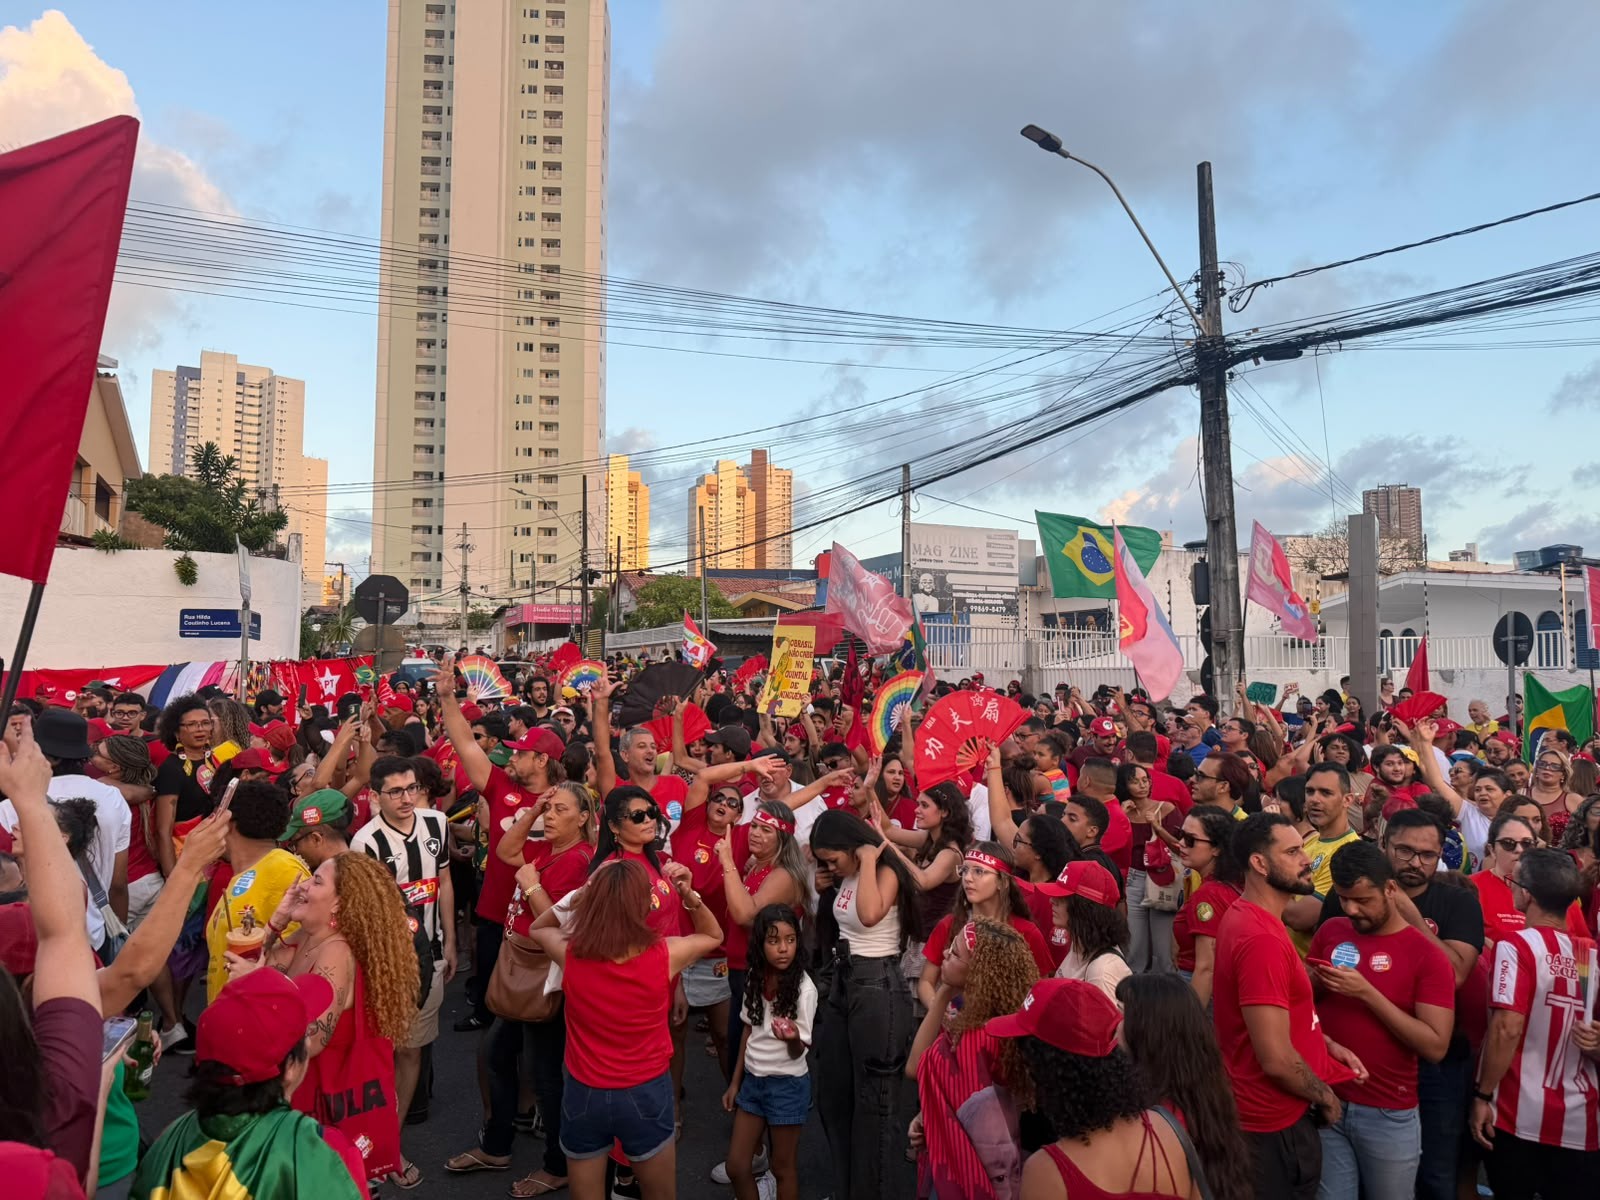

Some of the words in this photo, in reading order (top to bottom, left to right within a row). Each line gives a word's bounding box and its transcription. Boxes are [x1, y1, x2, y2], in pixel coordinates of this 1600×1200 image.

[788, 648, 800, 657] NÃO
[800, 650, 814, 659] CABE
[794, 660, 804, 669] NO
[784, 671, 808, 680] QUINTAL
[324, 680, 335, 689] PT
[789, 681, 800, 689] DE
[841, 888, 853, 901] LU
[1499, 959, 1509, 982] Chico
